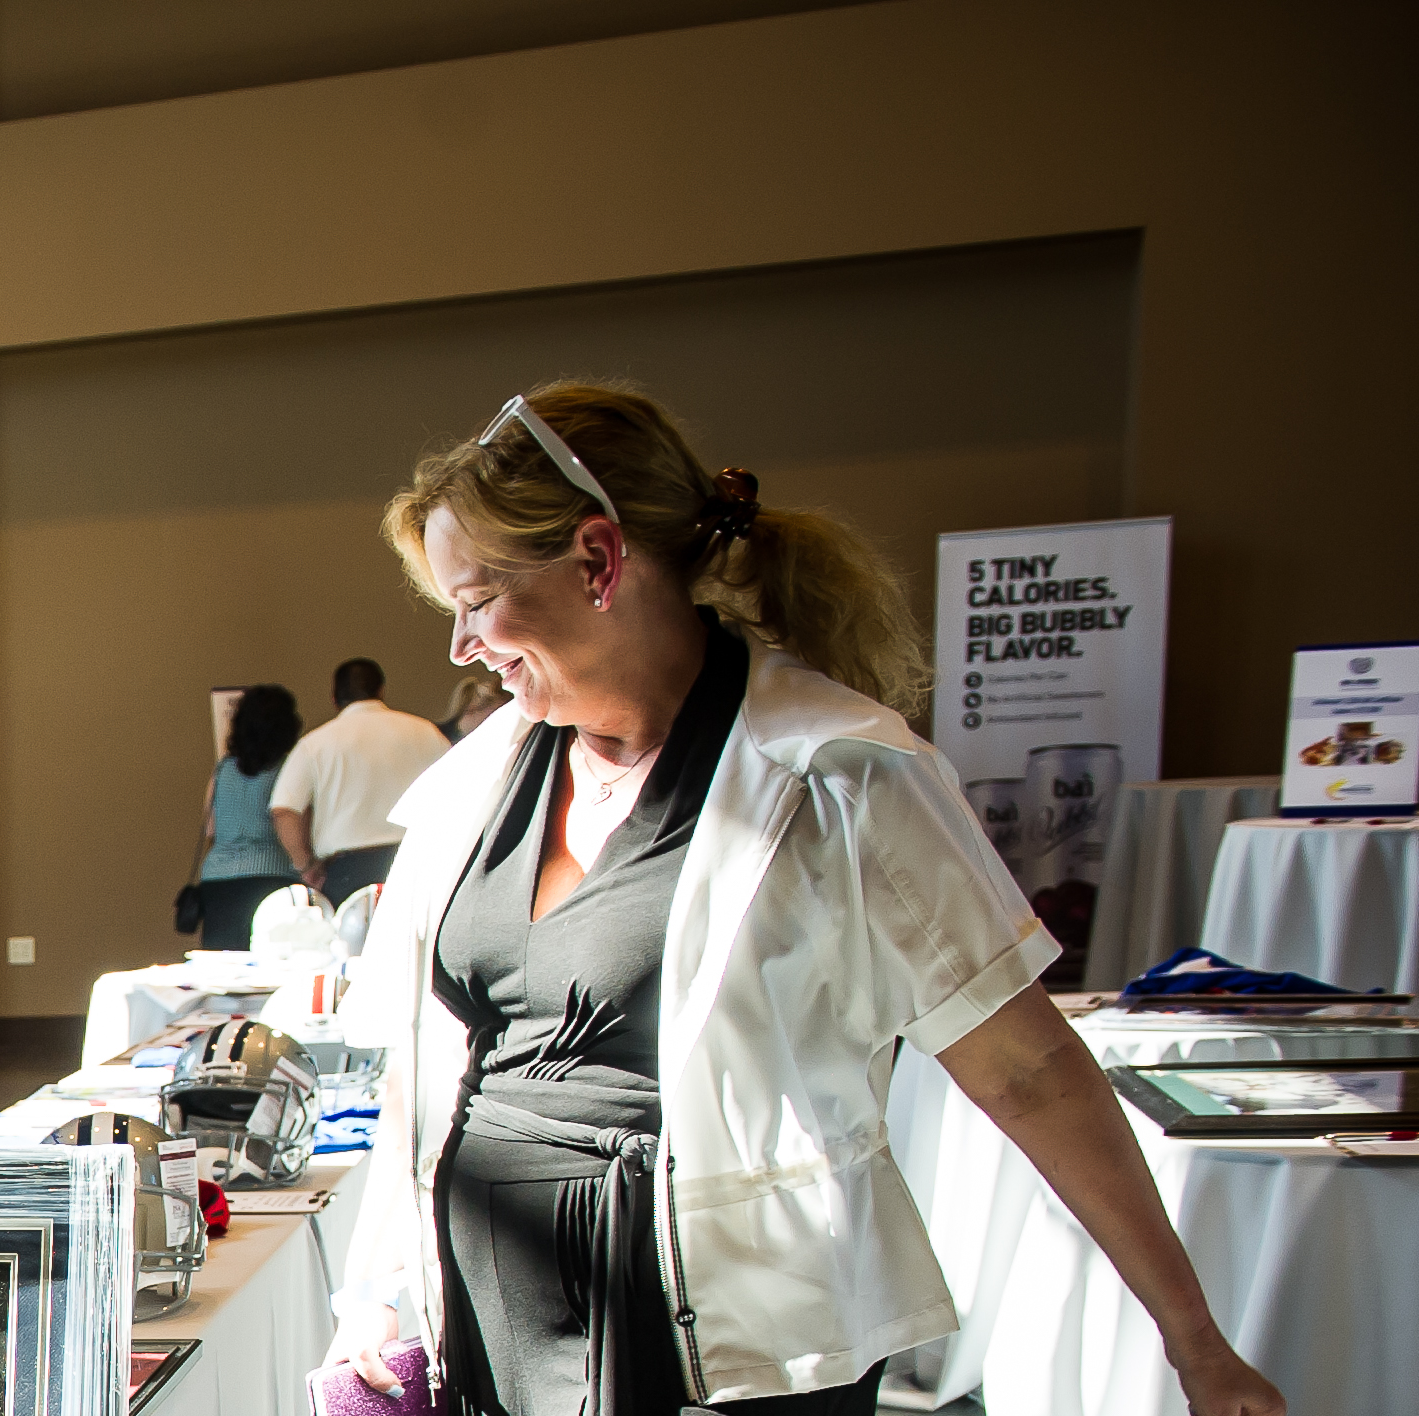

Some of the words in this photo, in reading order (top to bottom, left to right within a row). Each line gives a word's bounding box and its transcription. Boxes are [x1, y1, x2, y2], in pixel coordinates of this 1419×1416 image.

[968, 559, 985, 583] 5
[991, 553, 1059, 581] TINY
[967, 576, 1118, 608] CALORIES.
[966, 613, 1014, 638] BIG
[1020, 605, 1133, 634] BUBBLY
[966, 635, 1084, 663] FLAVOR.
